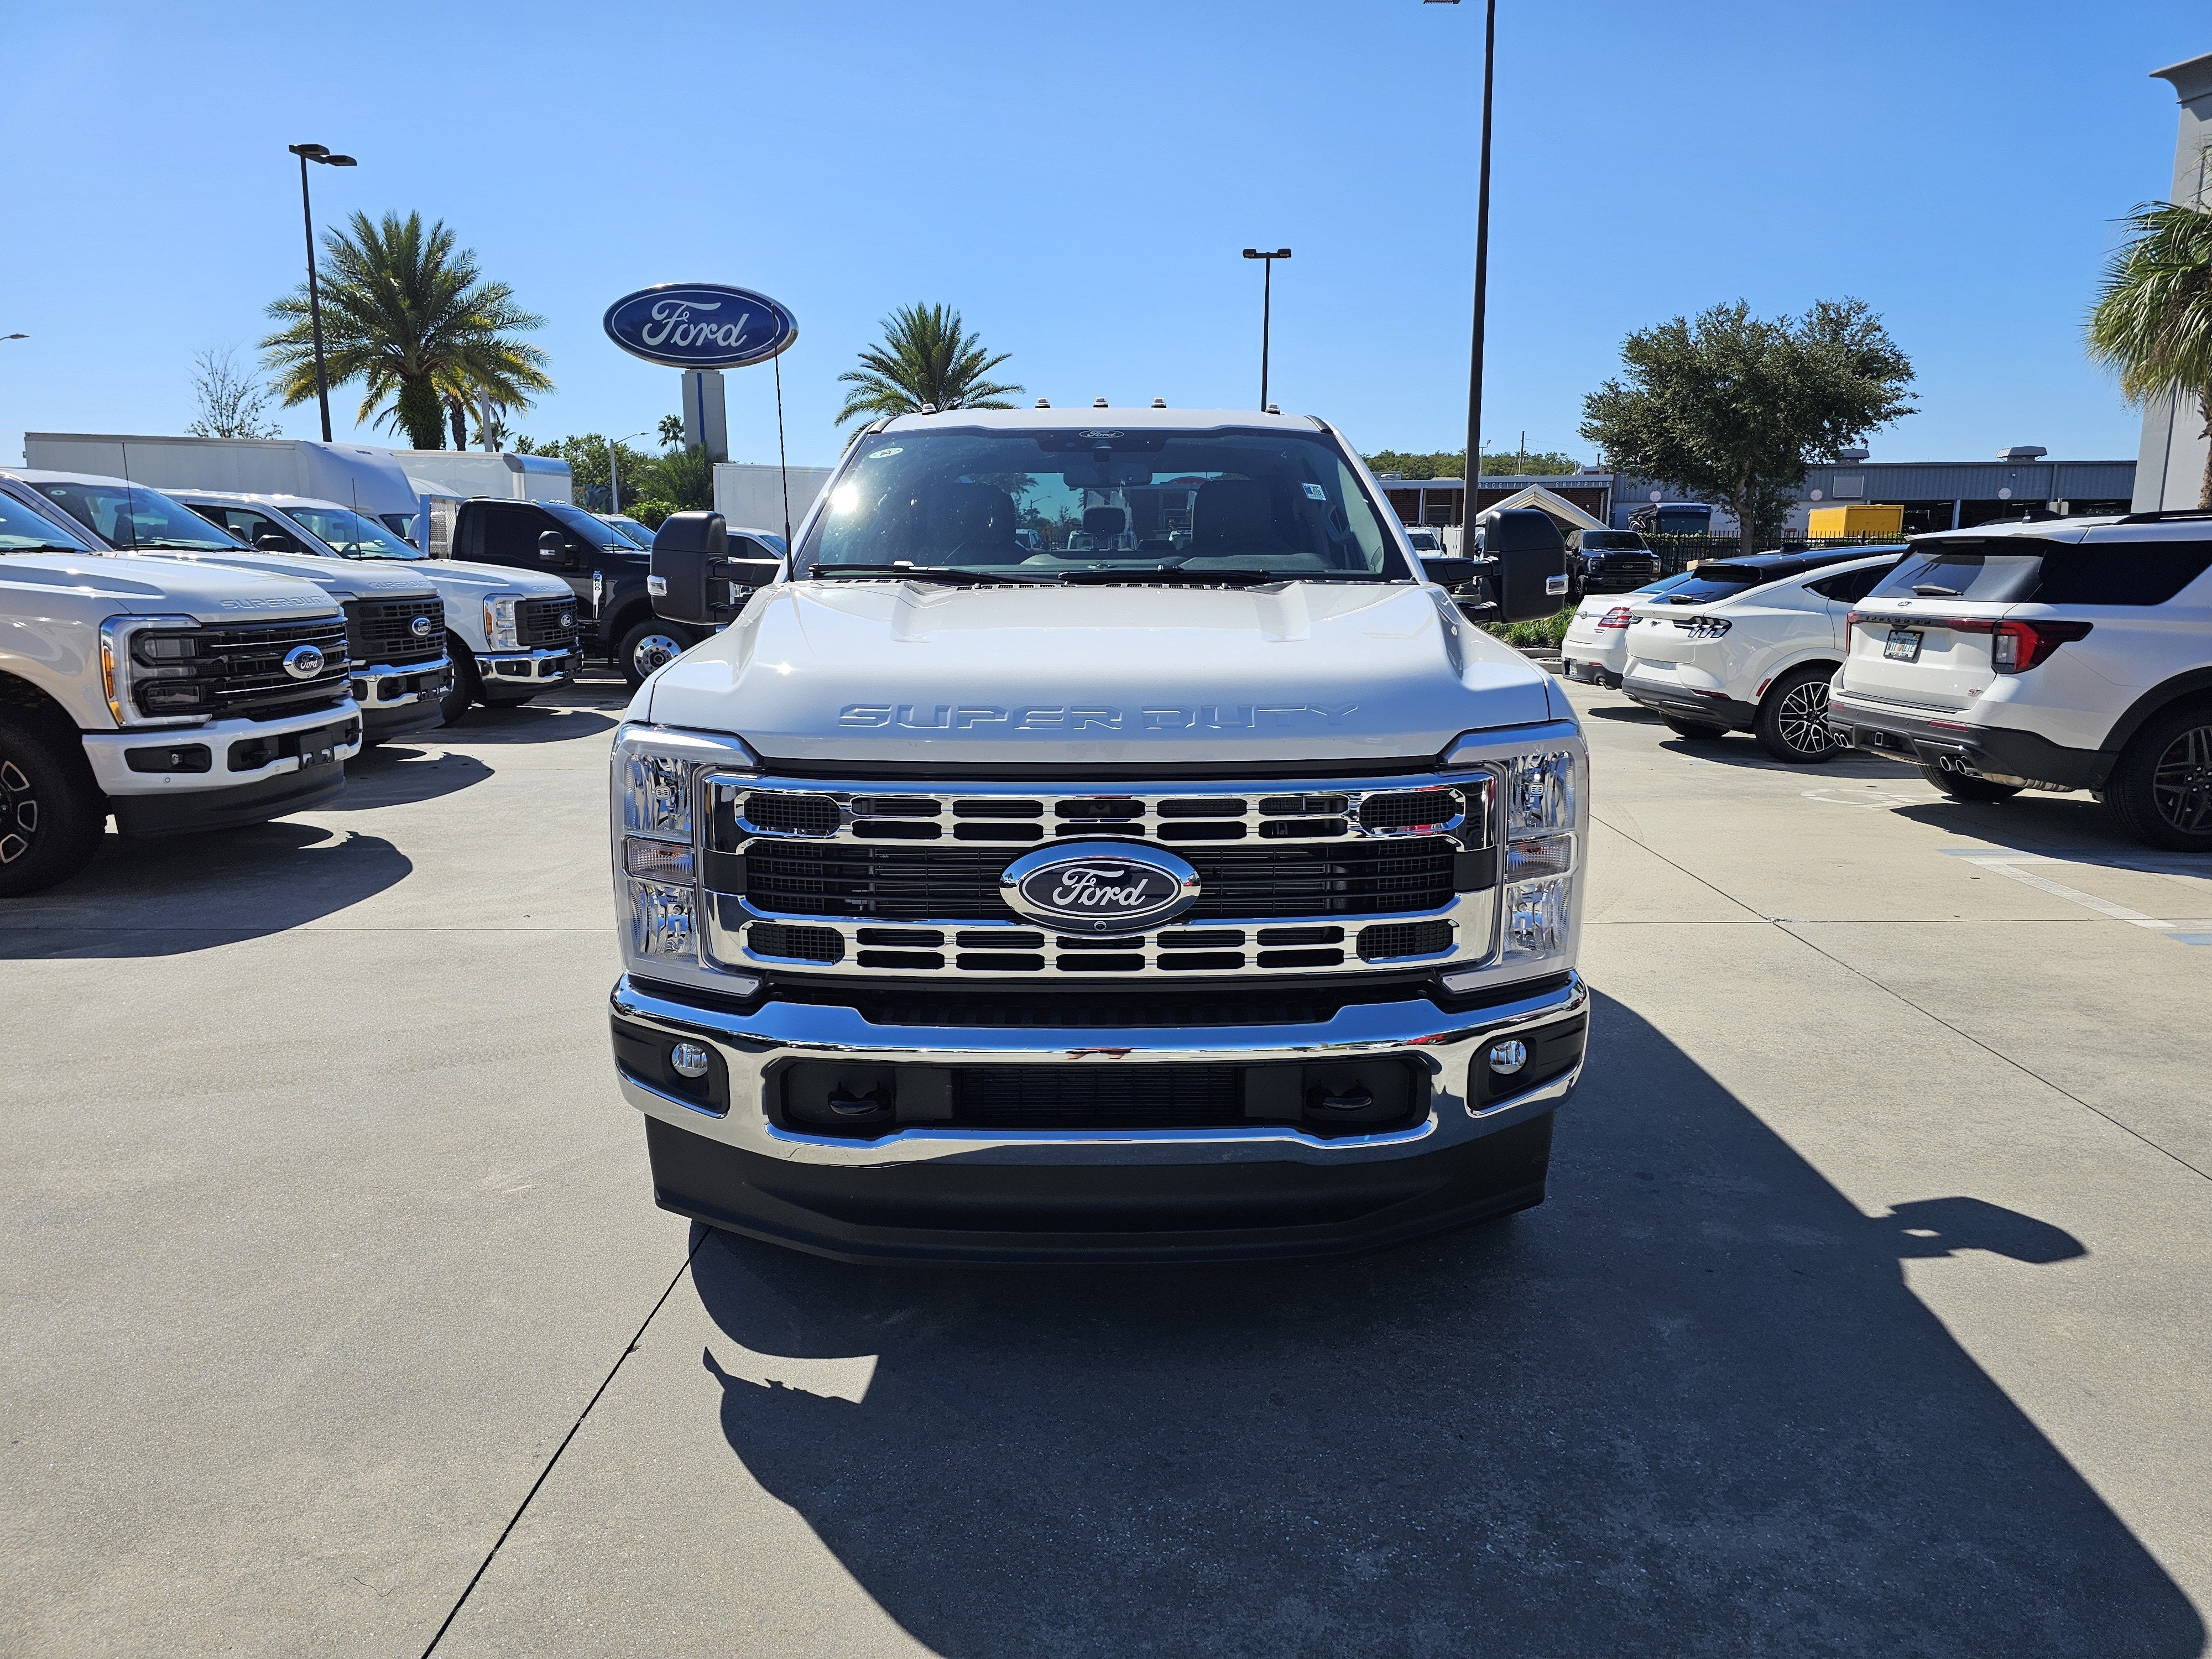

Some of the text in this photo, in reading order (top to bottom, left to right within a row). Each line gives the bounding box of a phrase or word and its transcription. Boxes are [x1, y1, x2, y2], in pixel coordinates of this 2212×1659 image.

[642, 299, 749, 347] Ford
[220, 595, 329, 609] SUPER DUTY
[300, 655, 319, 669] Ford
[838, 702, 1359, 729] SUPER DUTY
[1052, 868, 1149, 906] Ford
